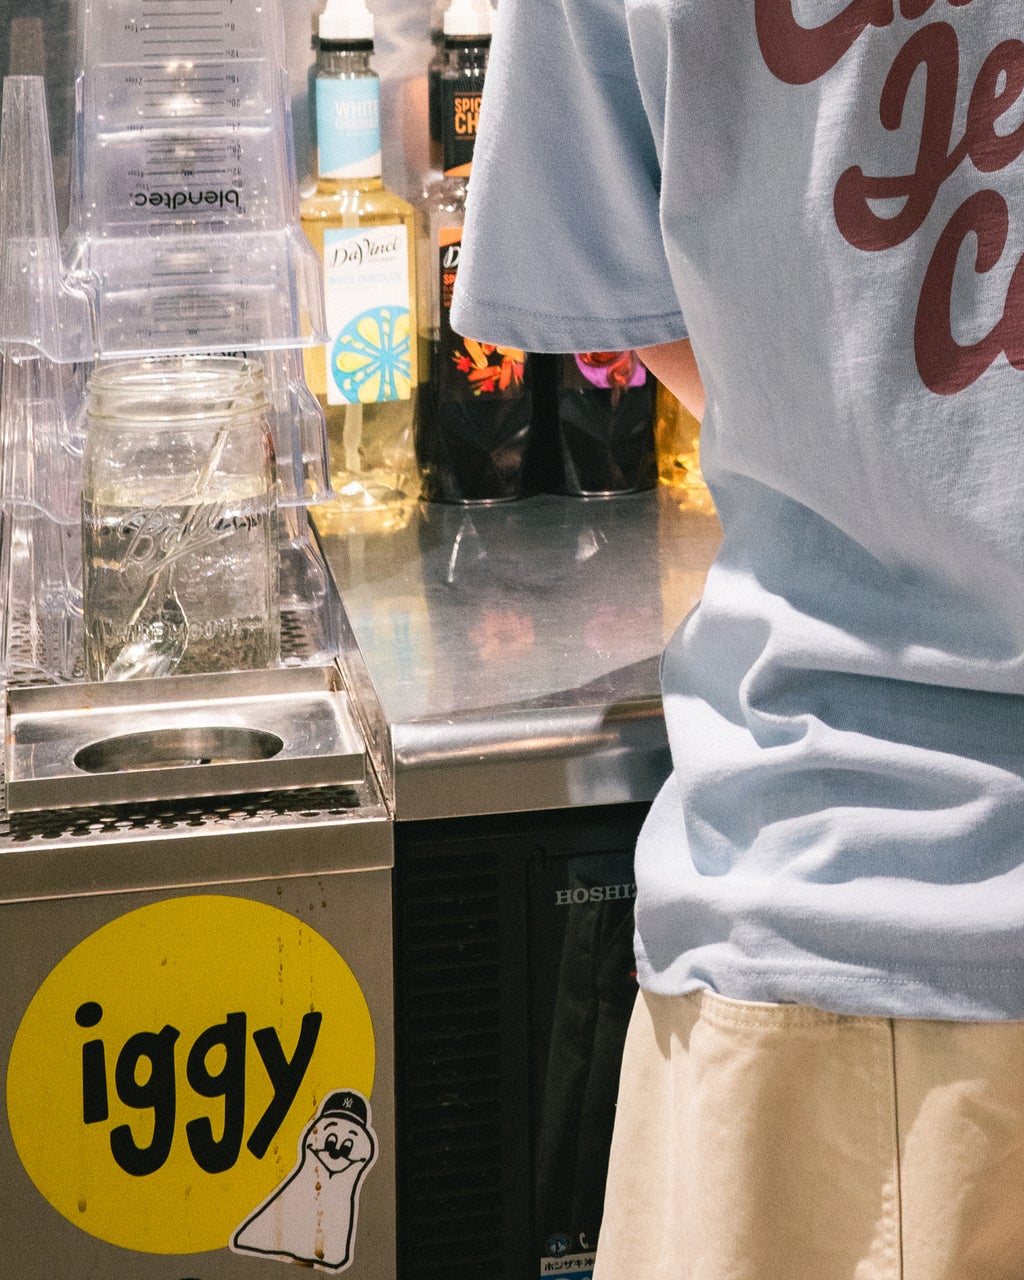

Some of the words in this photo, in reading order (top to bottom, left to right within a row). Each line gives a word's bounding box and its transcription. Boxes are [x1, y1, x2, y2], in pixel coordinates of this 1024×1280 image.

[134, 189, 240, 210] blendtec
[329, 237, 400, 268] DaVinci
[74, 1001, 323, 1177] iggy
